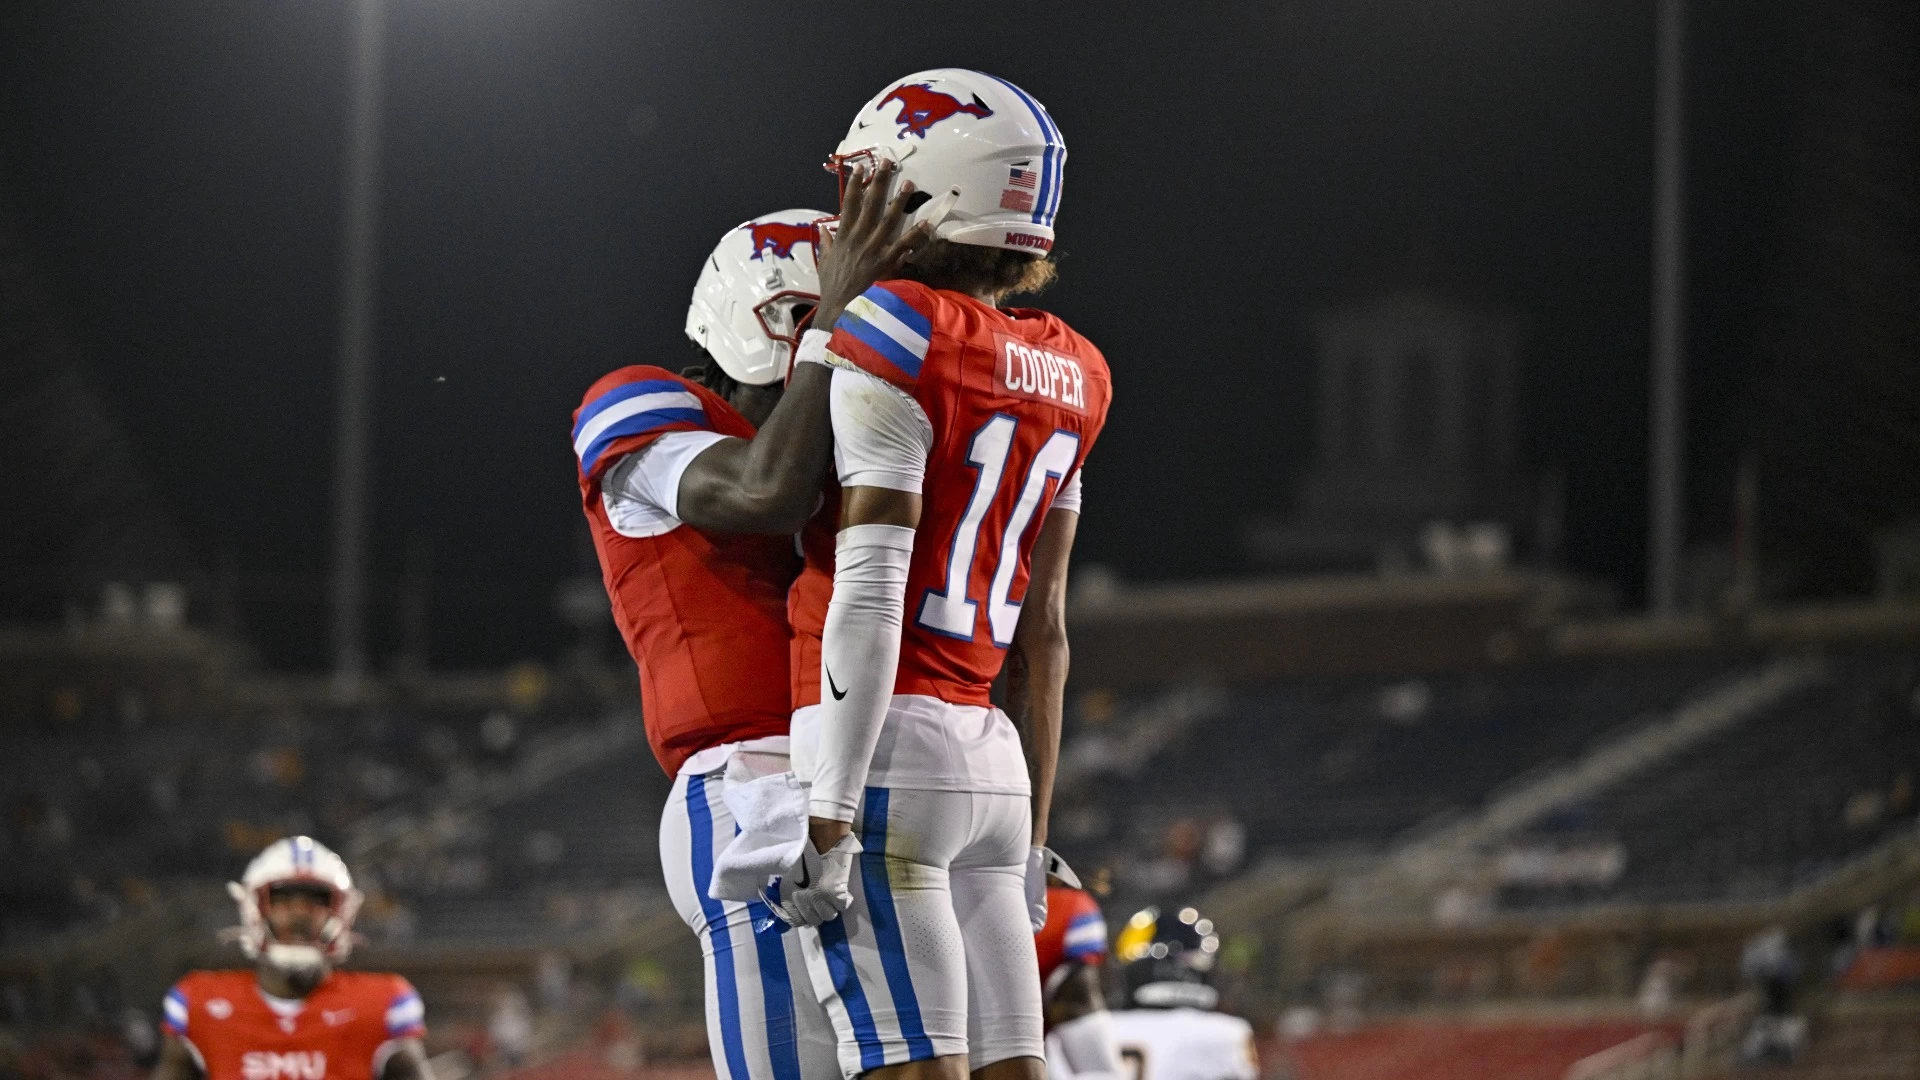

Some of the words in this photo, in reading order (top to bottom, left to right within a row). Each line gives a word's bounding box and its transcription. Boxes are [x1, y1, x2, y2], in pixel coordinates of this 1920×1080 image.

[1005, 341, 1085, 409] COOPER
[914, 412, 1081, 649] 10
[242, 1051, 327, 1080] SMU
